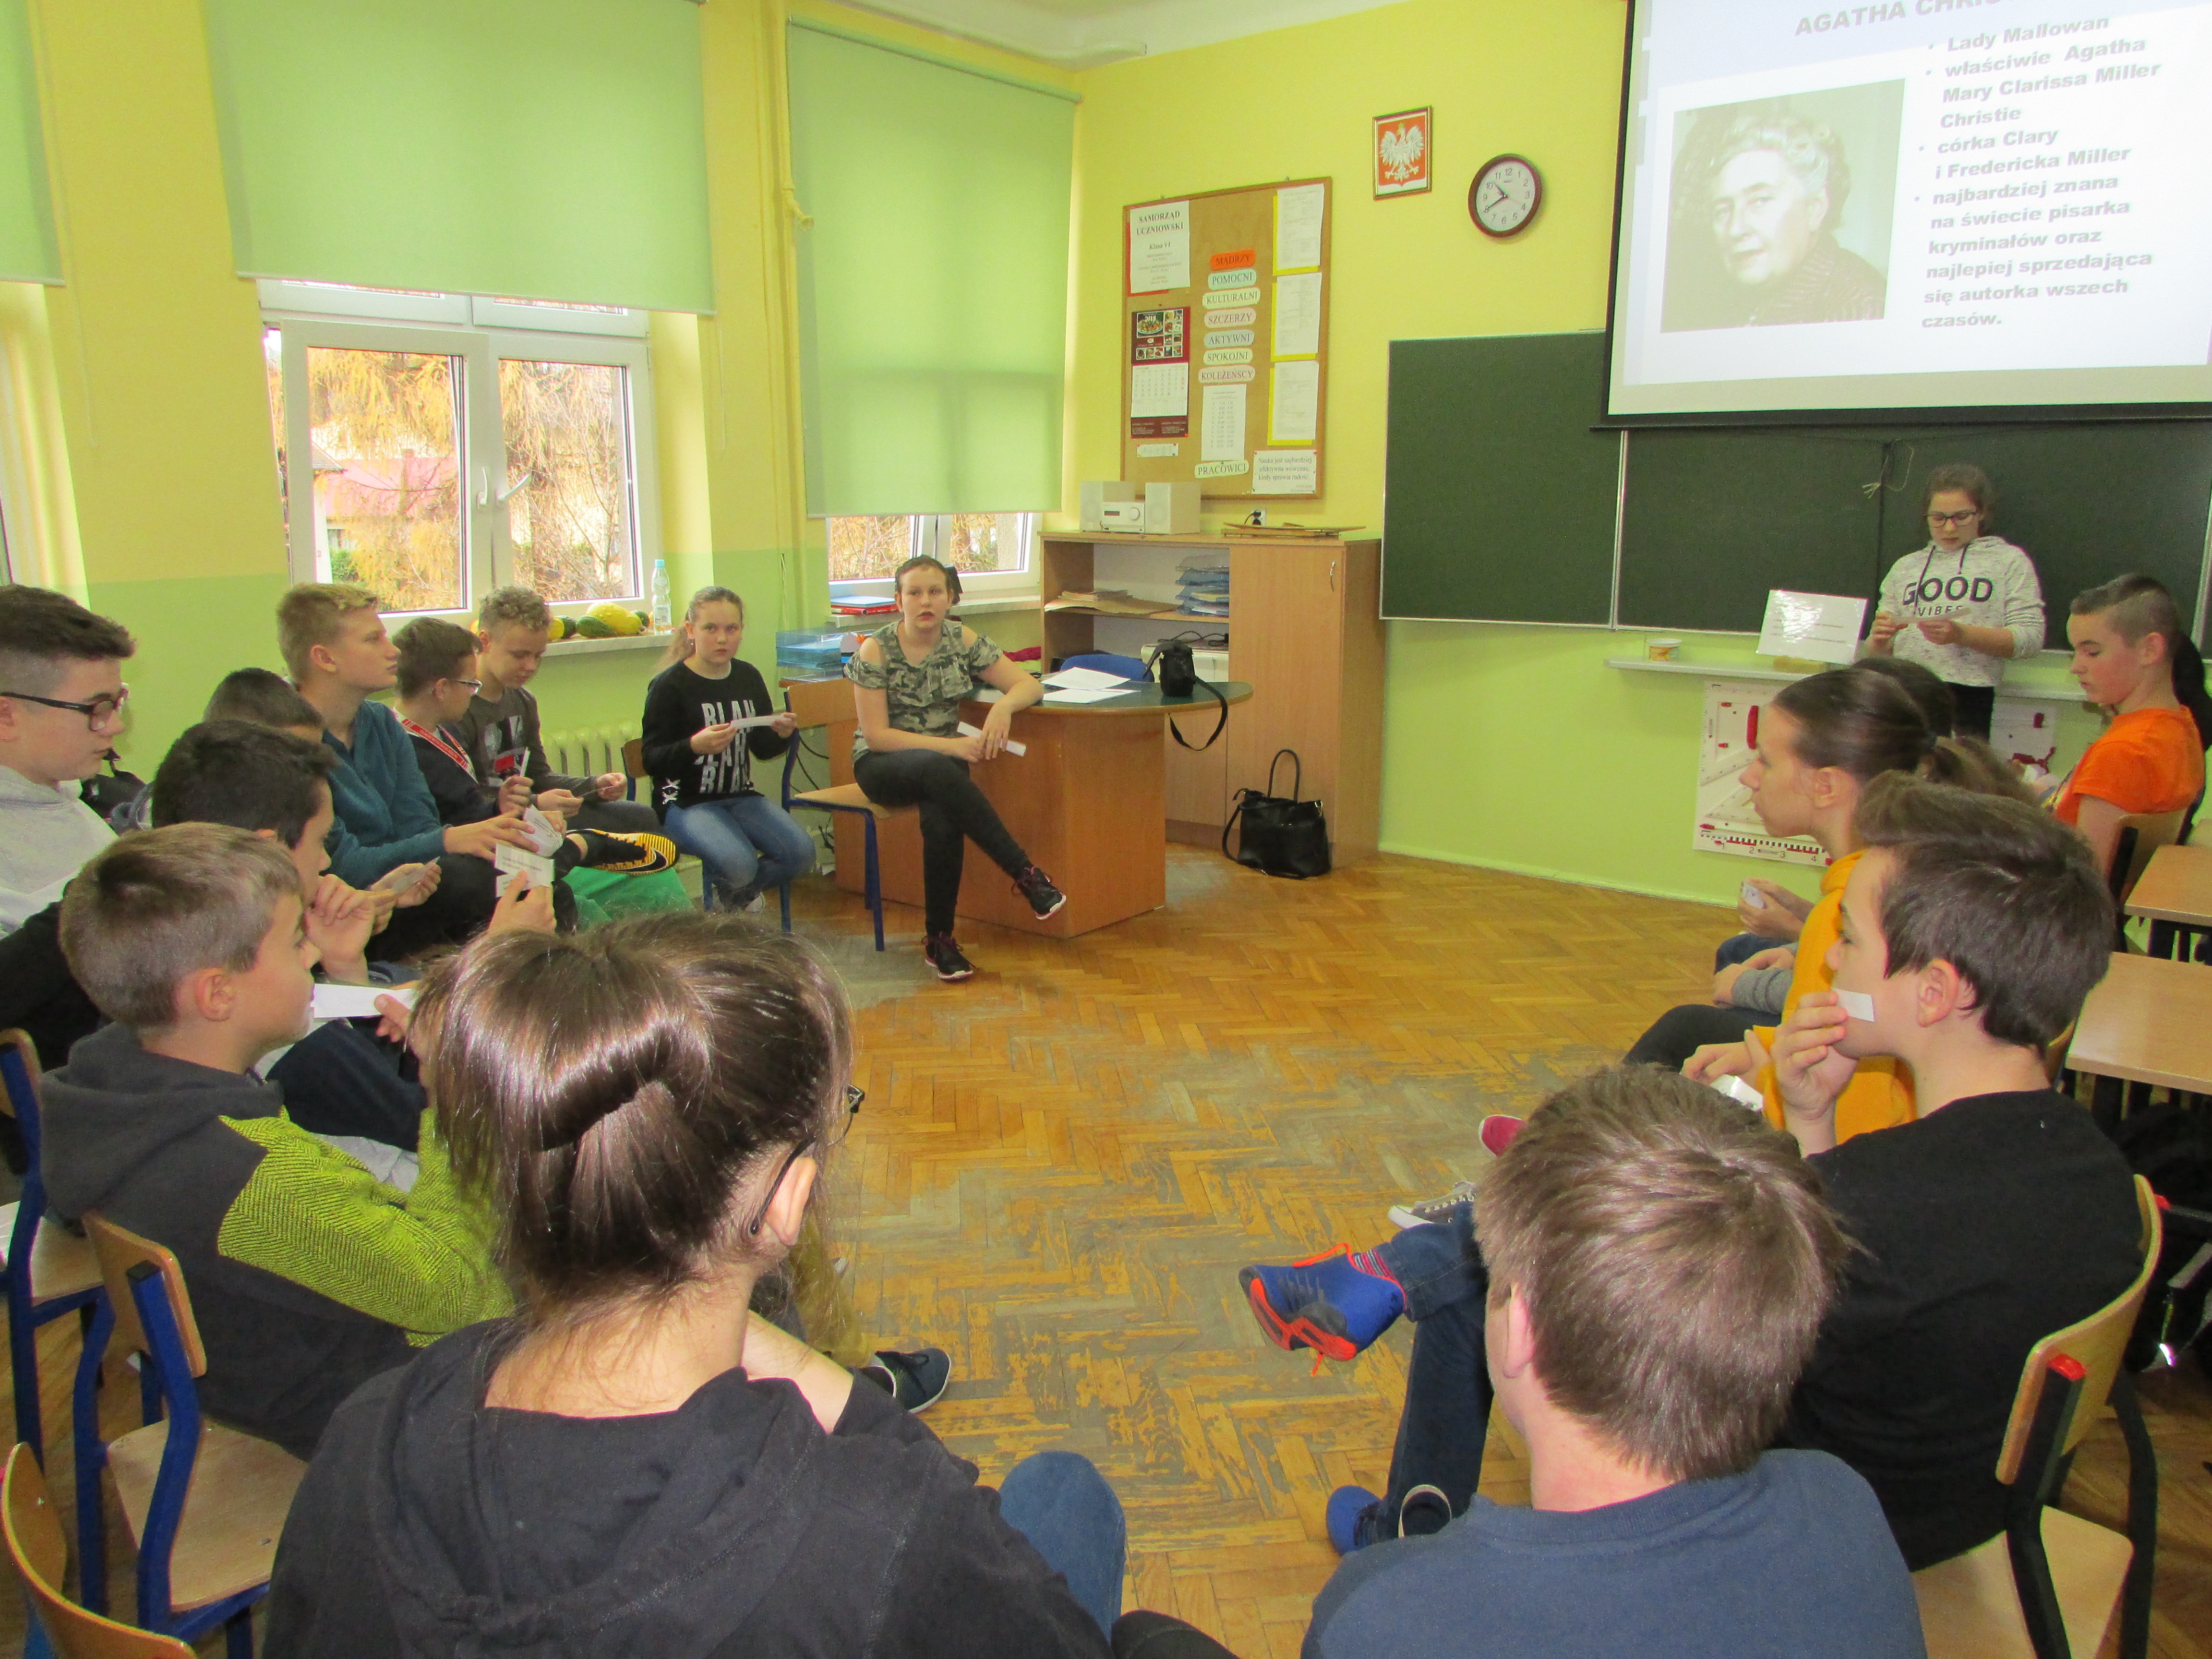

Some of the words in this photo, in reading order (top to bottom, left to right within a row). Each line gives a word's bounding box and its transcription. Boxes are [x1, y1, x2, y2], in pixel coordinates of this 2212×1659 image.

[1794, 1, 1906, 36] AGATHA
[1948, 33, 1996, 51] Lady
[2003, 17, 2109, 43] Mallowan
[1945, 51, 2051, 77] właściwie
[2064, 37, 2146, 62] Agatha
[1942, 86, 1992, 103] Mary
[1999, 73, 2087, 95] Clarissa
[2095, 62, 2162, 83] Miller
[1940, 107, 2021, 128] Christie
[1937, 136, 1996, 153] córka
[2003, 130, 2058, 146] Clary
[1505, 168, 1512, 176] 12
[1936, 166, 1941, 179] i
[1948, 155, 2059, 178] Fredericka
[2067, 148, 2131, 166] Miller
[1933, 180, 2047, 205] najbardziej
[2053, 177, 2119, 193] znana
[1139, 211, 1180, 223] SAMORZĄD
[1491, 214, 1496, 222] 7
[1931, 217, 1954, 229] na
[1960, 208, 2042, 227] świecie
[2048, 201, 2130, 223] pisarka
[1136, 222, 1184, 235] UCZNIOWSKI
[1928, 233, 2048, 256] kryminałów
[2055, 231, 2102, 245] oraz
[1215, 254, 1250, 266] MĄDRZY
[1926, 260, 2013, 280] najlepiej
[2019, 253, 2152, 275] sprzedająca
[1212, 272, 1252, 285] POMOCNI
[1207, 291, 1257, 304] KULTURALNI
[1923, 291, 1953, 306] się
[1959, 285, 2039, 301] autorka
[2046, 279, 2128, 296] wszech
[1208, 313, 1252, 325] SZCZERZY
[1921, 312, 2002, 328] czasów.
[1209, 334, 1250, 345] AKTYWNI
[1207, 352, 1248, 361] SPOKOJNI
[1202, 369, 1253, 380] KOLEŻEŃSCY
[1198, 463, 1246, 475] PRACOWICI
[1902, 577, 1993, 605] GOOD
